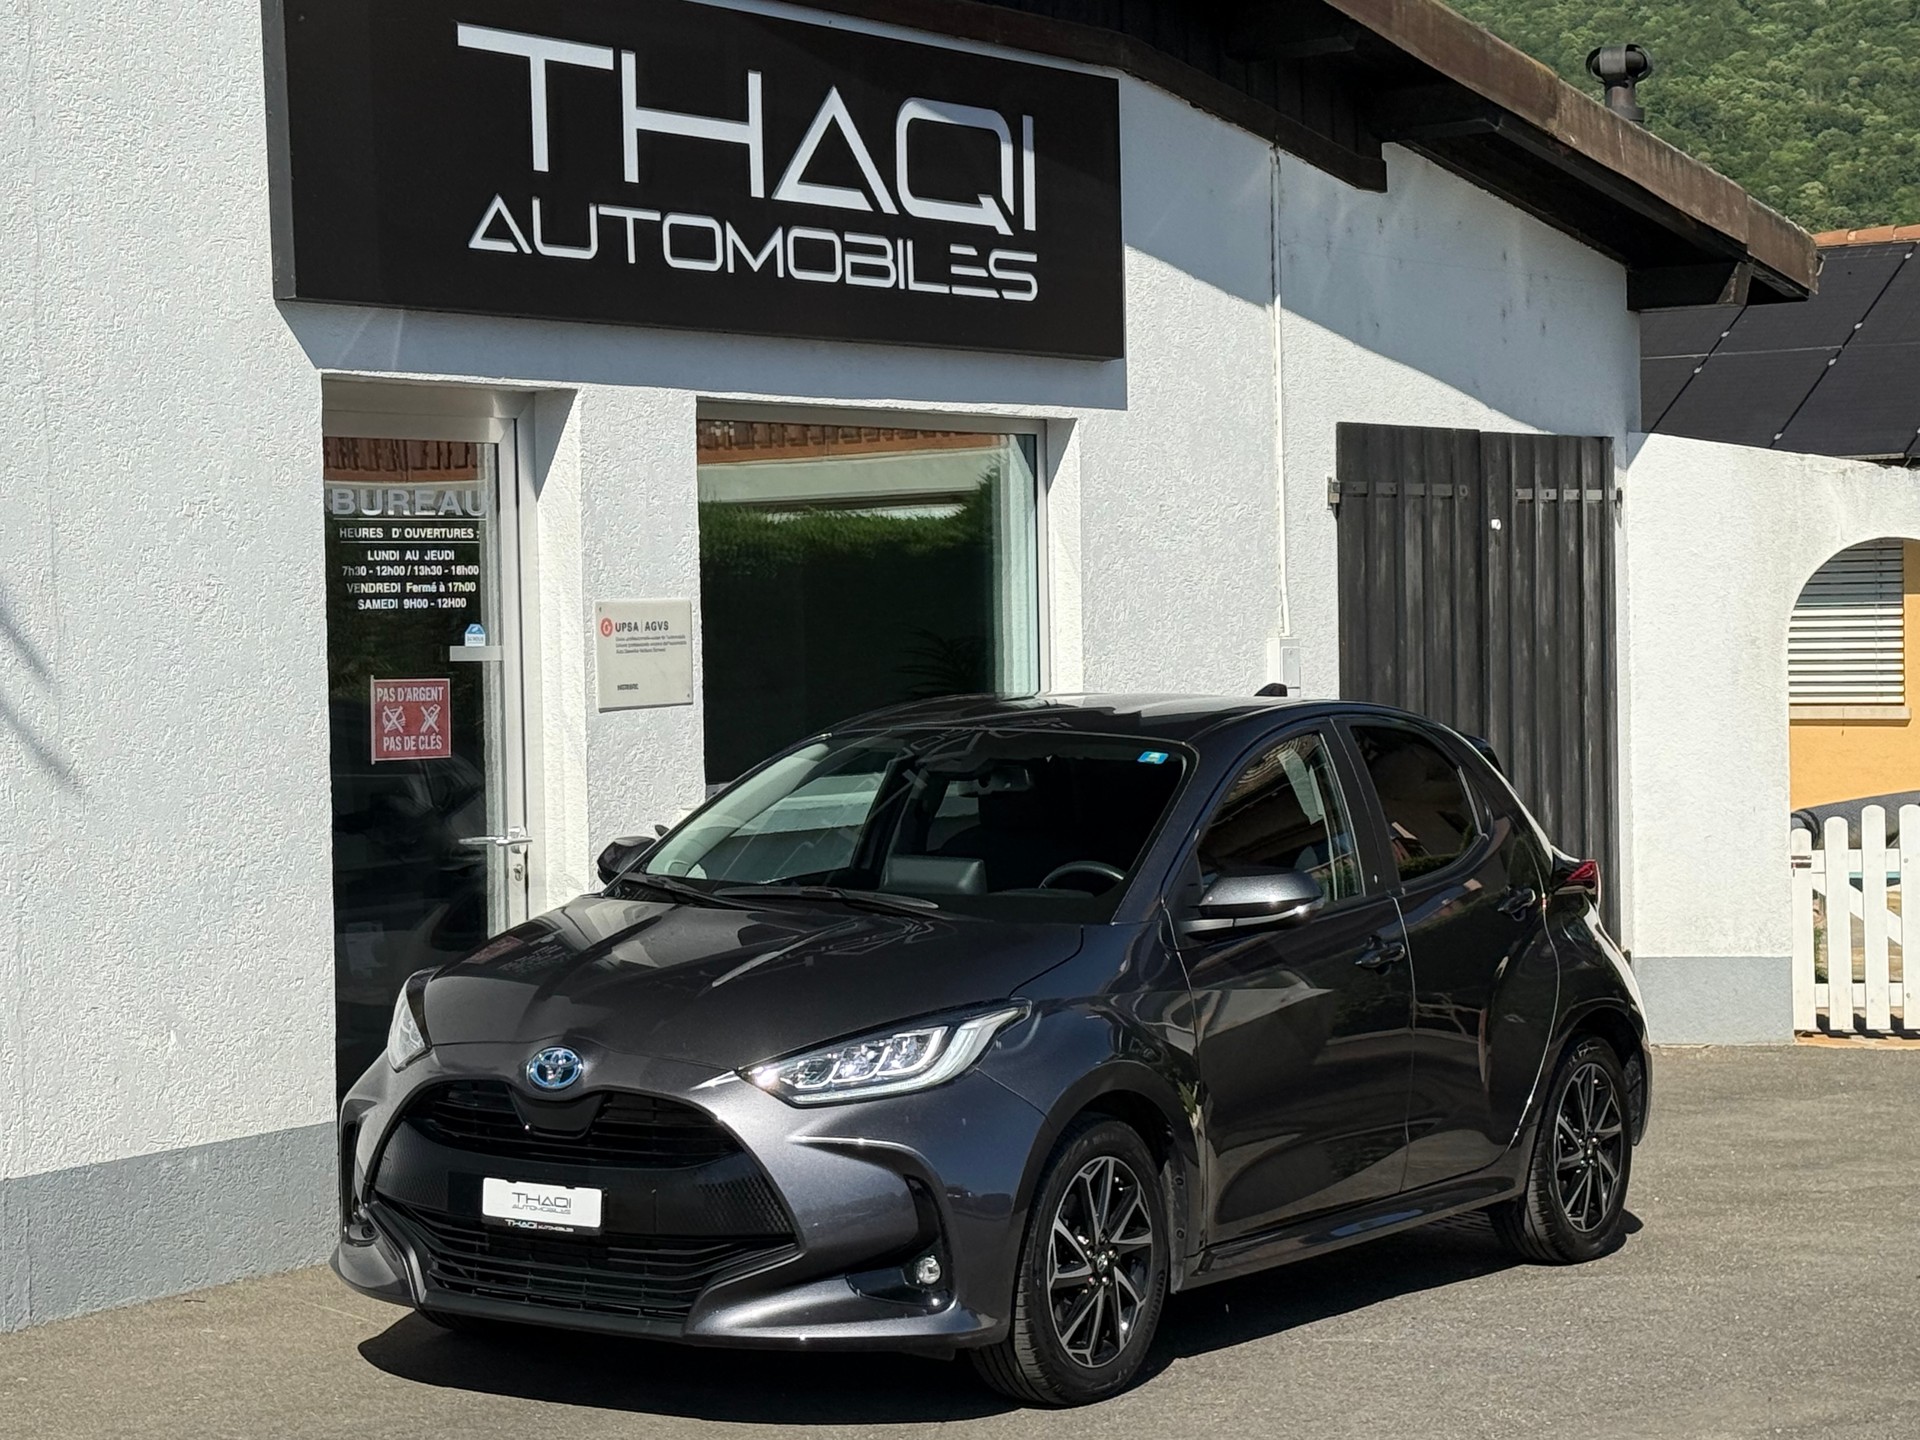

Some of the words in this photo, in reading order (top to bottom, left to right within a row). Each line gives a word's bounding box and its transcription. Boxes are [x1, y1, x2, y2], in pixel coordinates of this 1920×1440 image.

[457, 22, 1037, 236] THAQI
[468, 193, 1039, 302] AUTOMOBILES
[331, 488, 489, 516] BUREAU
[339, 527, 384, 539] HEURES
[367, 550, 400, 561] LUNDI
[404, 550, 420, 561] AU
[424, 550, 455, 561] JEUDI
[342, 565, 367, 577] 7h30
[376, 565, 406, 577] 12h00
[413, 565, 443, 577] 13h30
[346, 582, 401, 594] VENDREDI
[406, 582, 437, 593] Fermé
[439, 582, 446, 593] à
[448, 581, 477, 593] 17h00
[357, 598, 399, 611] SAMEDI
[403, 598, 429, 610] 9H00
[438, 597, 467, 609] 12H00
[615, 622, 639, 633] UPSA
[644, 620, 669, 632] AGVS
[376, 687, 395, 702] PAS
[397, 686, 444, 702] D'ARGENT
[383, 735, 401, 752] PAS
[403, 735, 417, 751] DE
[418, 732, 442, 750] CLÉS
[512, 1192, 571, 1208] THAQI
[505, 1218, 537, 1229] THAQI
